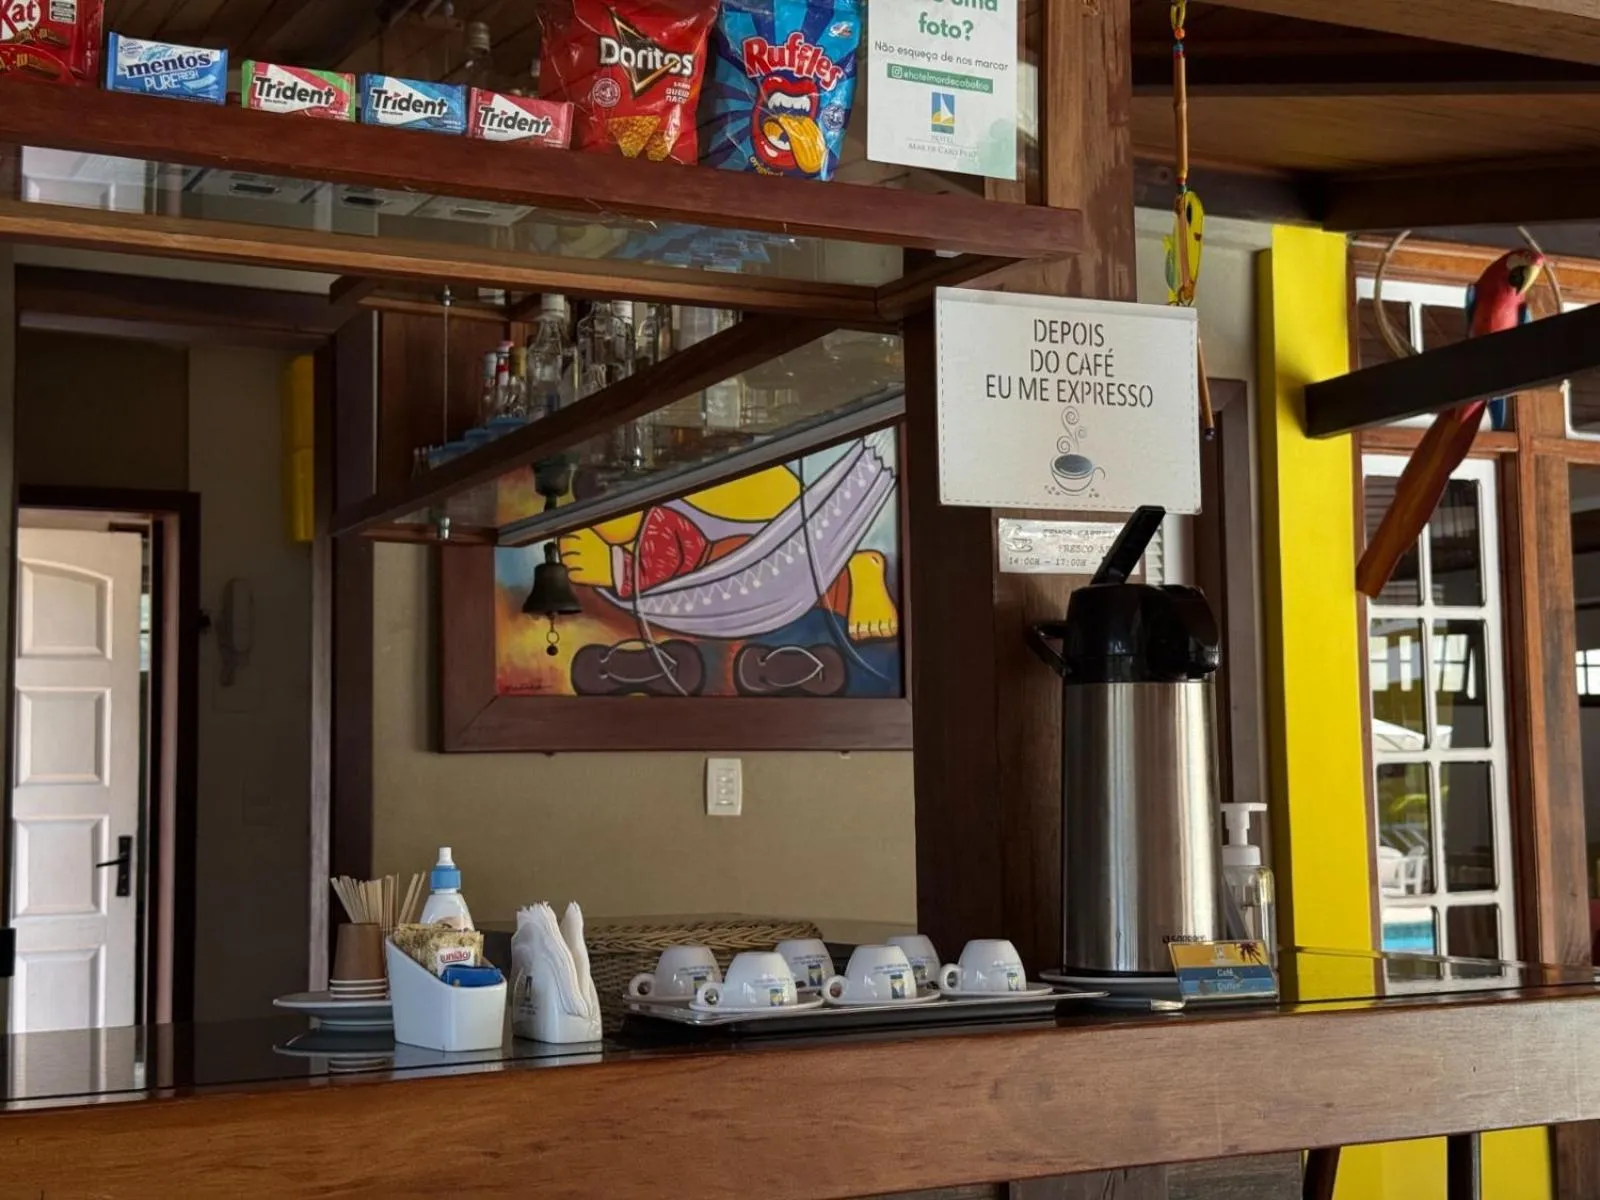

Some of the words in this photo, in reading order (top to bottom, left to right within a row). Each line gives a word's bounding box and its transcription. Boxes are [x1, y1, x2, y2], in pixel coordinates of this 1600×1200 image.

[918, 12, 975, 41] foto?
[126, 52, 212, 77] mentos
[600, 36, 695, 76] Doritos
[743, 32, 844, 91] Ruffles
[874, 41, 895, 53] Não
[898, 47, 938, 62] esqueça
[940, 51, 953, 63] de
[956, 57, 973, 66] nos
[975, 60, 1009, 71] marcar
[144, 73, 180, 91] PURE
[255, 76, 335, 105] Trident
[372, 88, 447, 115] Trident
[480, 106, 551, 134] Trident
[1033, 319, 1105, 348] DEPOIS
[1030, 349, 1060, 374] DO
[1066, 348, 1115, 378] CAFÉ
[986, 374, 1012, 400] EU
[1018, 376, 1049, 402] ME
[1057, 379, 1154, 408] EXPRESSO
